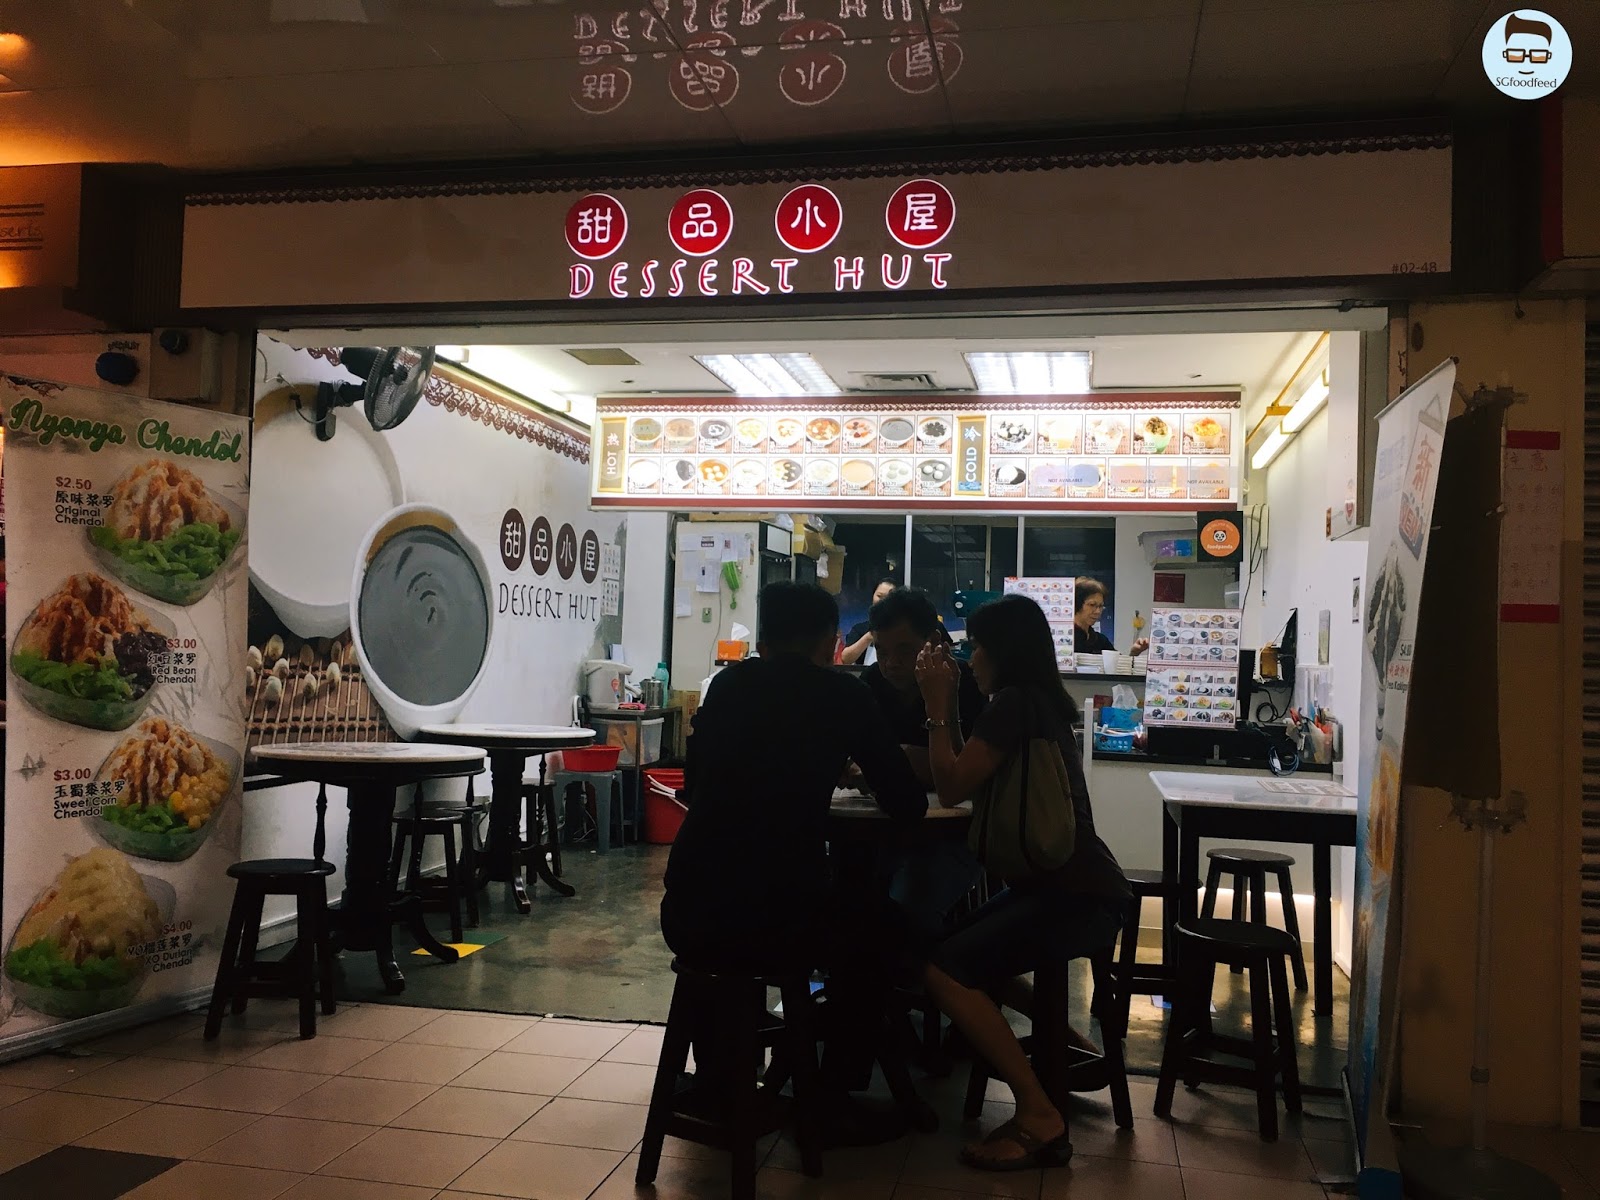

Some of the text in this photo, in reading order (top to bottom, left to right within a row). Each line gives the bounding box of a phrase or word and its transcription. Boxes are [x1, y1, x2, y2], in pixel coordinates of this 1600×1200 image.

[576, 192, 938, 244] 甜品小屋
[568, 252, 953, 299] DESSERT HUT
[8, 397, 243, 463] Nyonya Chendol
[606, 451, 618, 475] HOT
[965, 446, 978, 483] COLD
[55, 476, 92, 490] $2.50
[55, 504, 101, 517] Original
[55, 513, 105, 527] Chendol
[504, 521, 597, 572] 甜品小屋
[498, 582, 598, 622] DESSERT HUT
[167, 638, 197, 649] $3.00
[152, 666, 197, 675] Red Bean
[156, 674, 197, 684] Chendol
[53, 767, 91, 781] $3.00
[53, 796, 117, 810] Sweet Corn
[53, 806, 103, 819] Chendol
[163, 920, 192, 935] $4.00
[145, 948, 193, 966] XO Durian
[152, 956, 193, 973] Chendol
